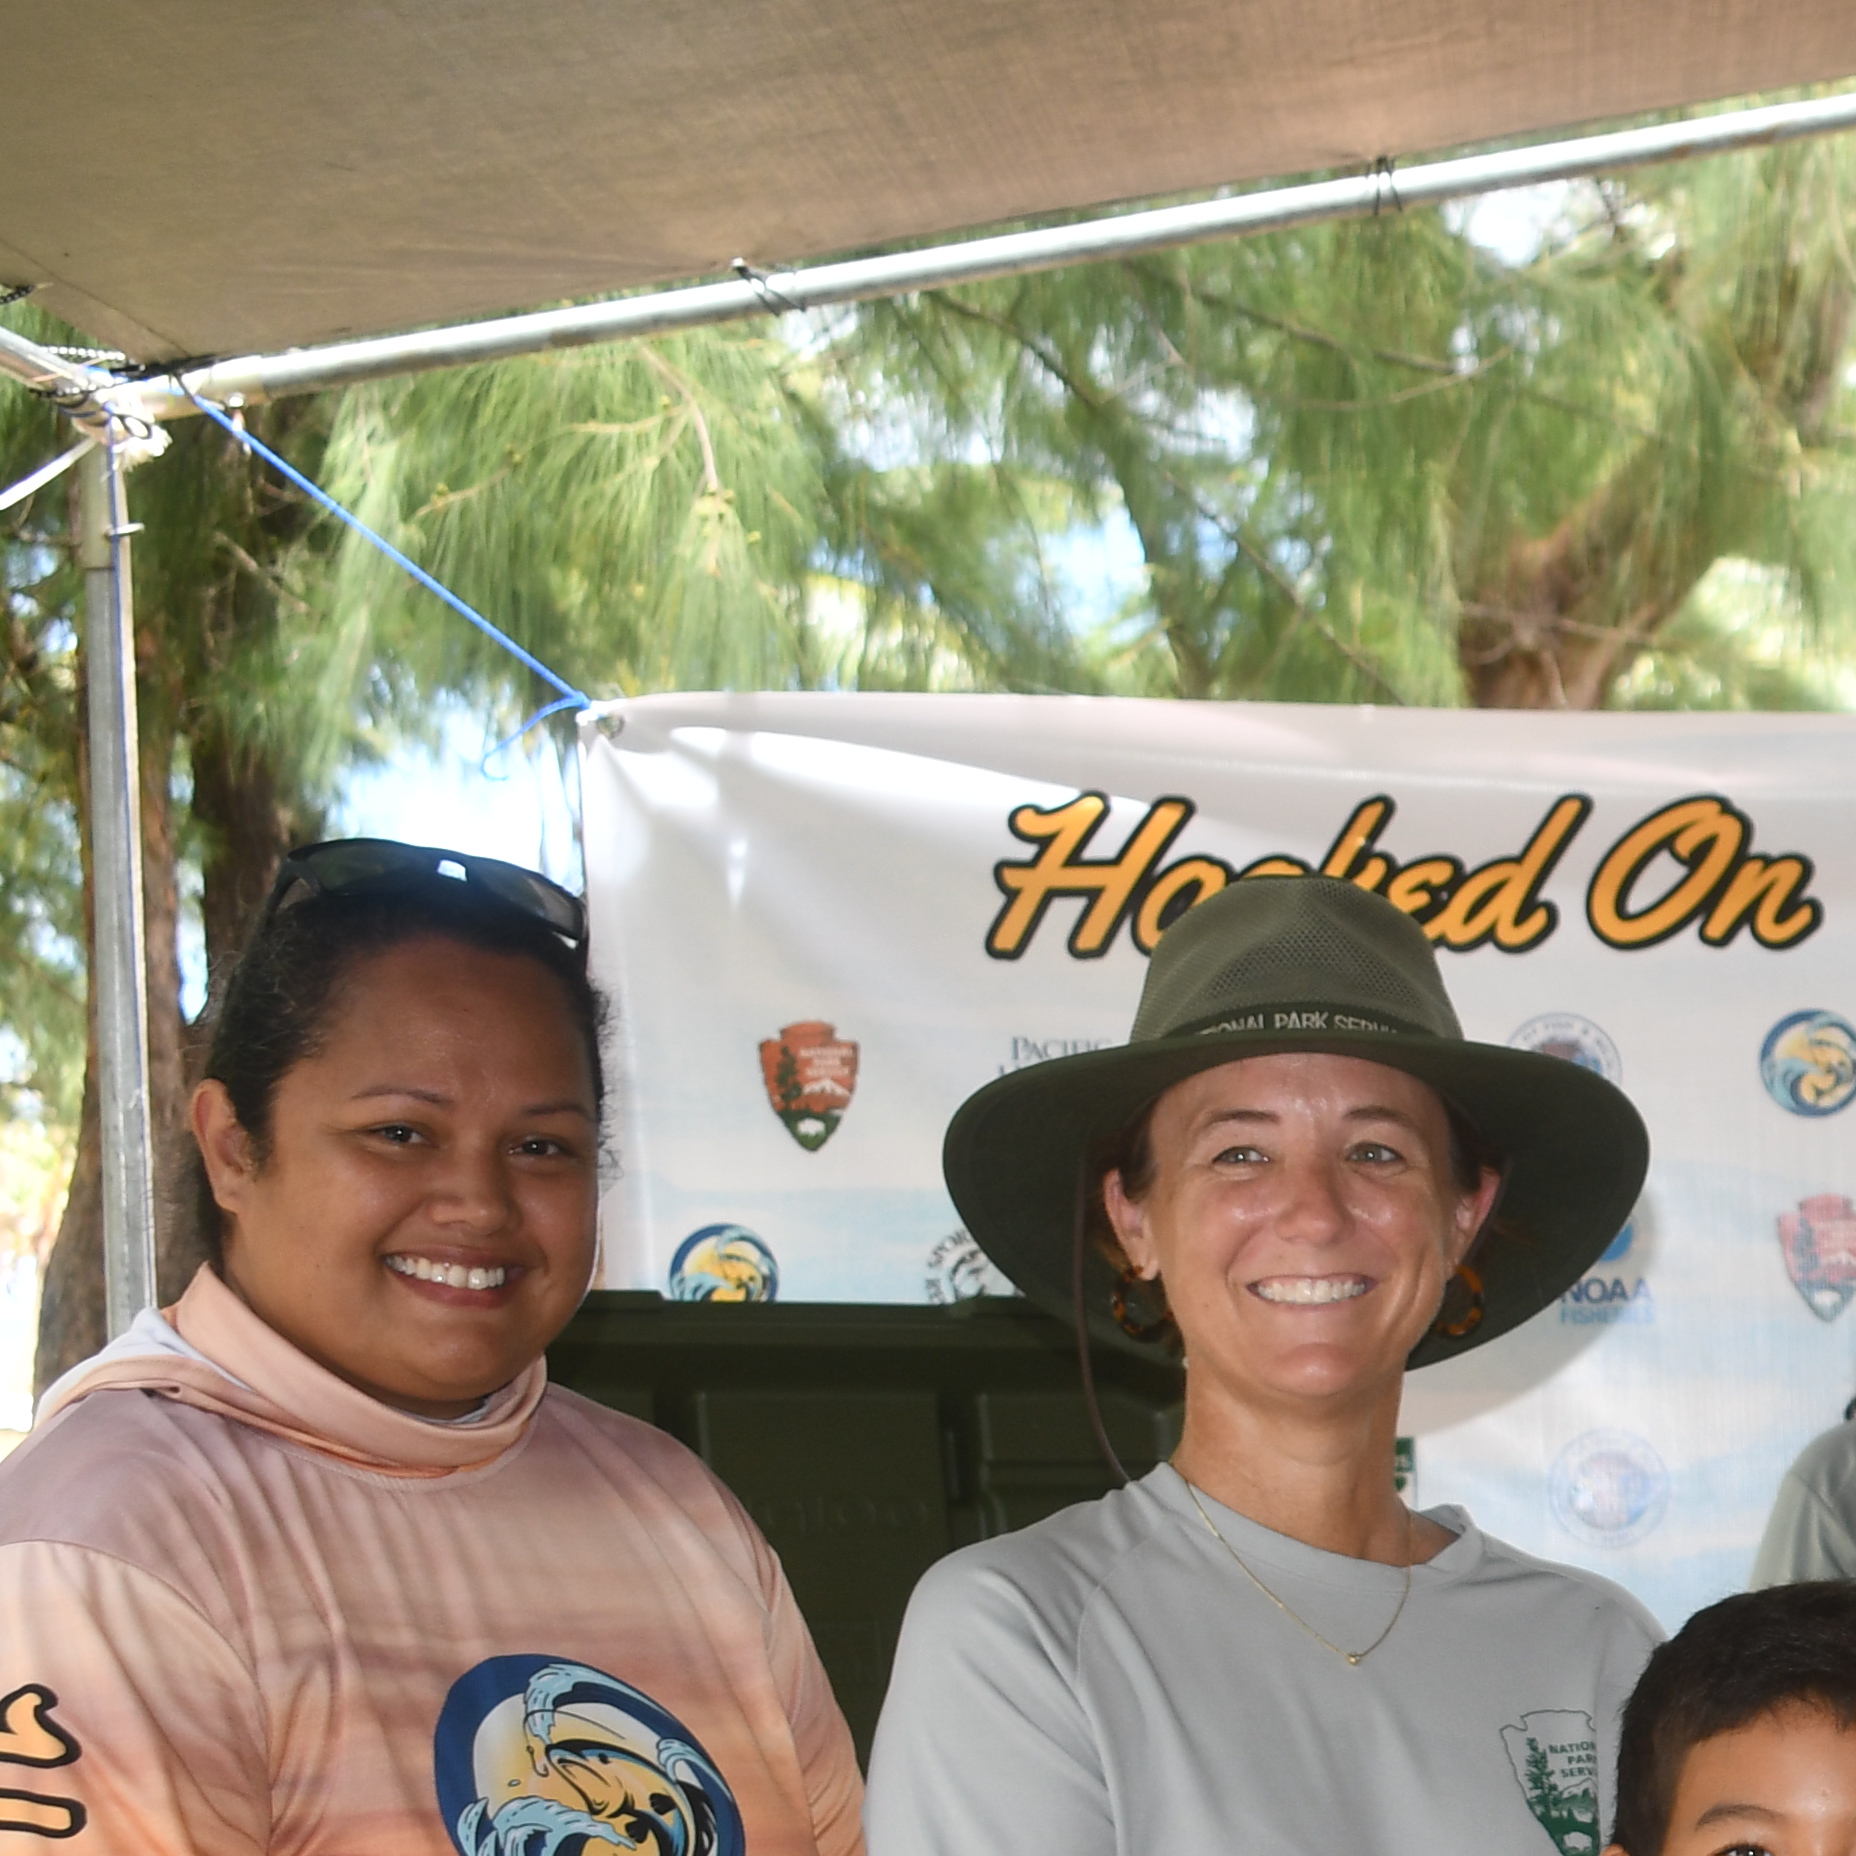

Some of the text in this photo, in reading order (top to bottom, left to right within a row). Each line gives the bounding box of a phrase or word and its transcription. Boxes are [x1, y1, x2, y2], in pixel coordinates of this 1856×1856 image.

[985, 790, 1592, 960] Hoked
[1586, 792, 1824, 949] On
[1274, 1011, 1329, 1030] PARK
[1012, 1037, 1114, 1061] PACIFI
[1548, 1740, 1597, 1755] NATION
[1567, 1754, 1597, 1765] PAR
